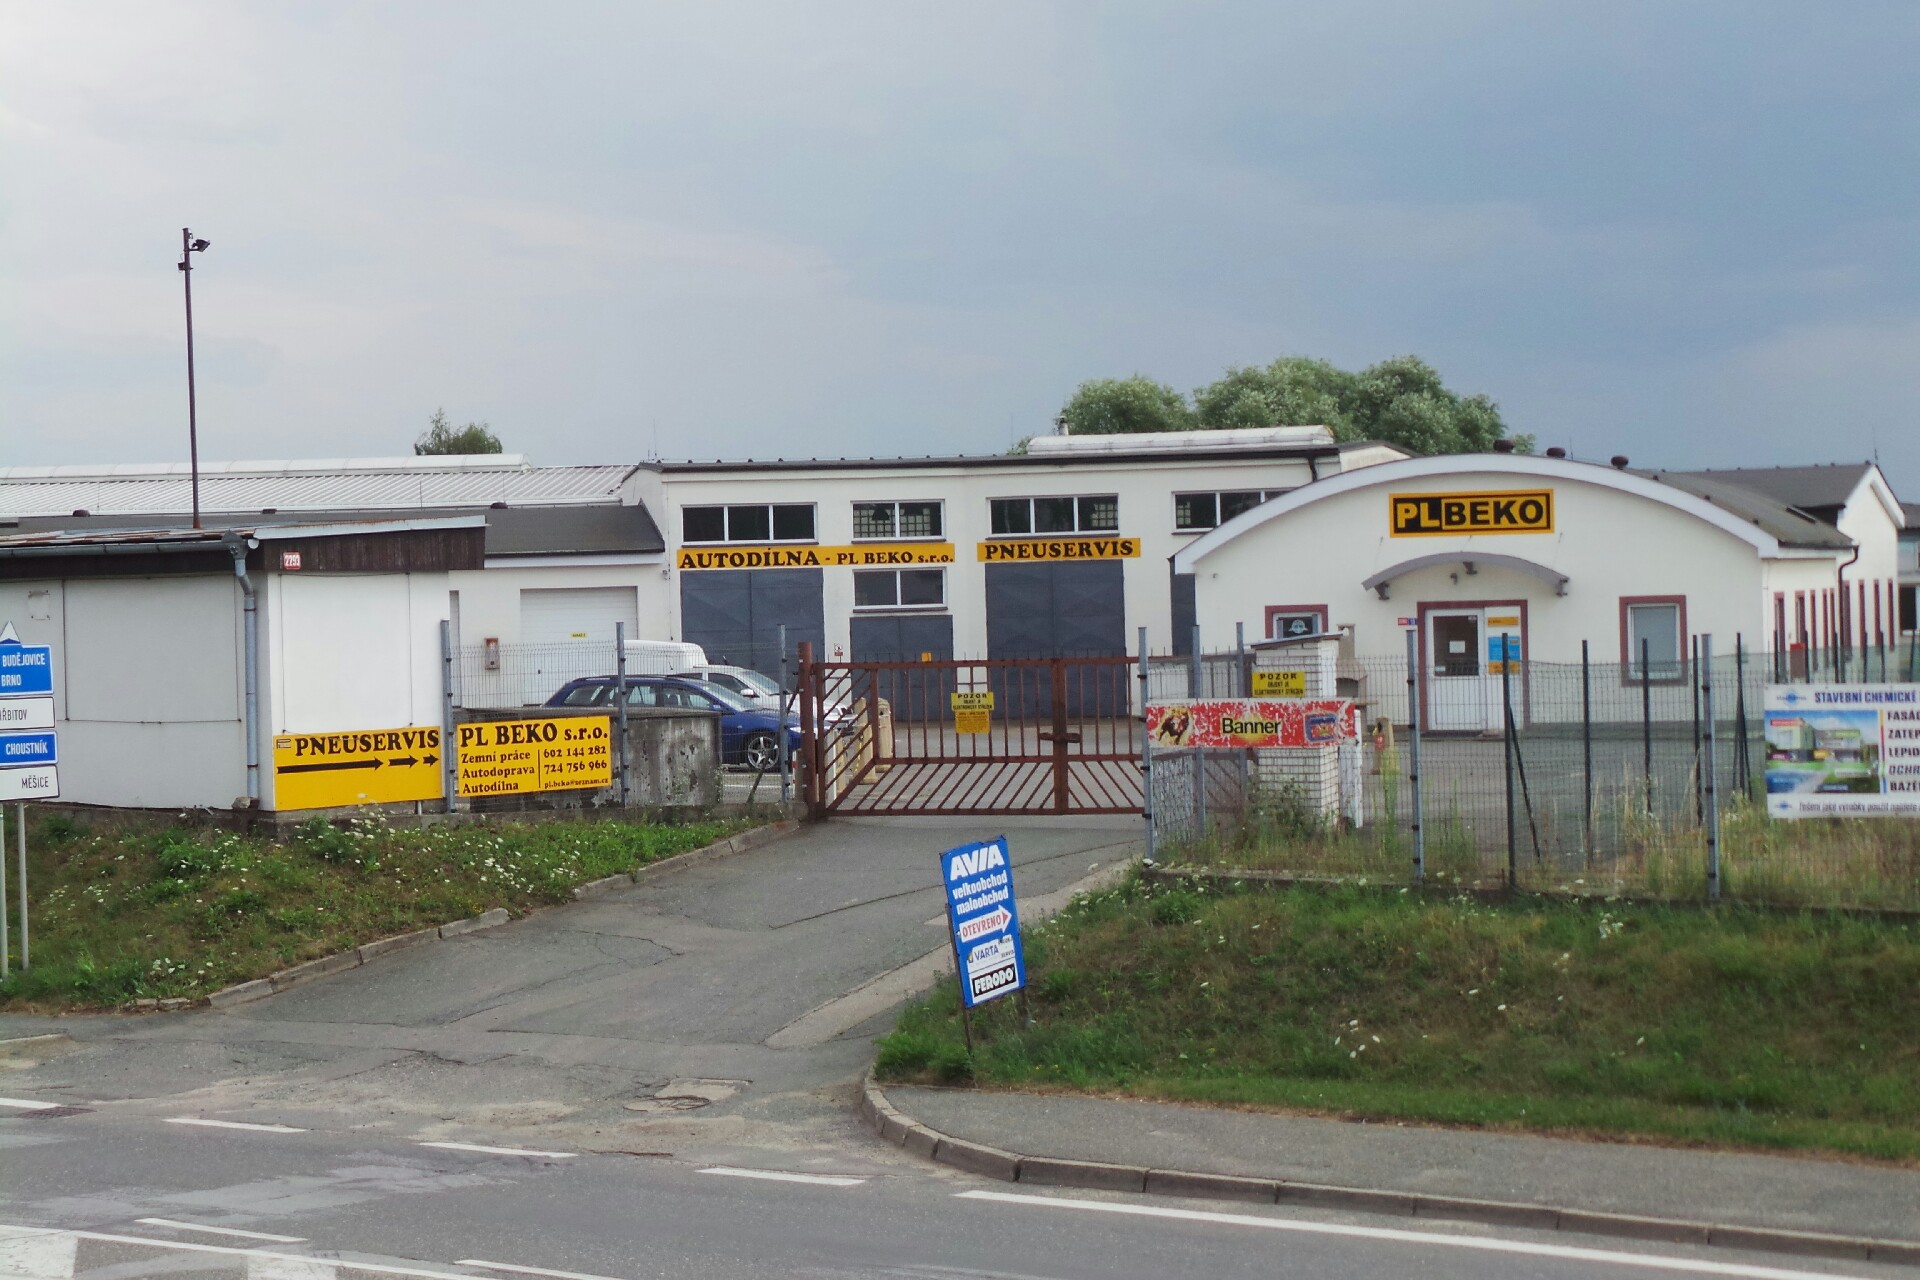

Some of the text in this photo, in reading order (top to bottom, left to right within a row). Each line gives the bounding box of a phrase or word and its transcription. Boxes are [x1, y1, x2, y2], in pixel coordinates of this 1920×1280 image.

[985, 541, 1133, 559] PNEUSERVIS
[679, 548, 820, 568] AUTODÍLNA
[837, 553, 858, 565] PL
[864, 551, 913, 564] BEKO
[917, 554, 954, 563] s.r.o.
[2, 652, 46, 667] BUDĚJOVICE
[1, 674, 22, 687] BRNO
[1814, 690, 1862, 703] STAVEBNÍ
[1864, 689, 1916, 703] CHEMICKÉ
[0, 707, 28, 721] ŘBITOV
[1222, 718, 1281, 734] Banner
[460, 722, 608, 747] PL BEKO s.r.o.
[5, 740, 48, 755] CHOUSTNÍK
[295, 730, 439, 756] PNEUSERVIS
[461, 749, 531, 764] Zemní práce
[543, 745, 606, 758] 602 144 282
[462, 765, 535, 779] Autodoprava
[544, 760, 607, 774] 724 756 966
[21, 775, 49, 789] MĚŠICE
[463, 781, 519, 794] Autodílna
[1890, 780, 1920, 792] BAZÉ
[950, 844, 1005, 881] AVIA
[952, 869, 1008, 900] velkoobchod
[956, 885, 1009, 916] maloobchod
[974, 944, 999, 961] VARTA
[974, 967, 1014, 994] FERODO
